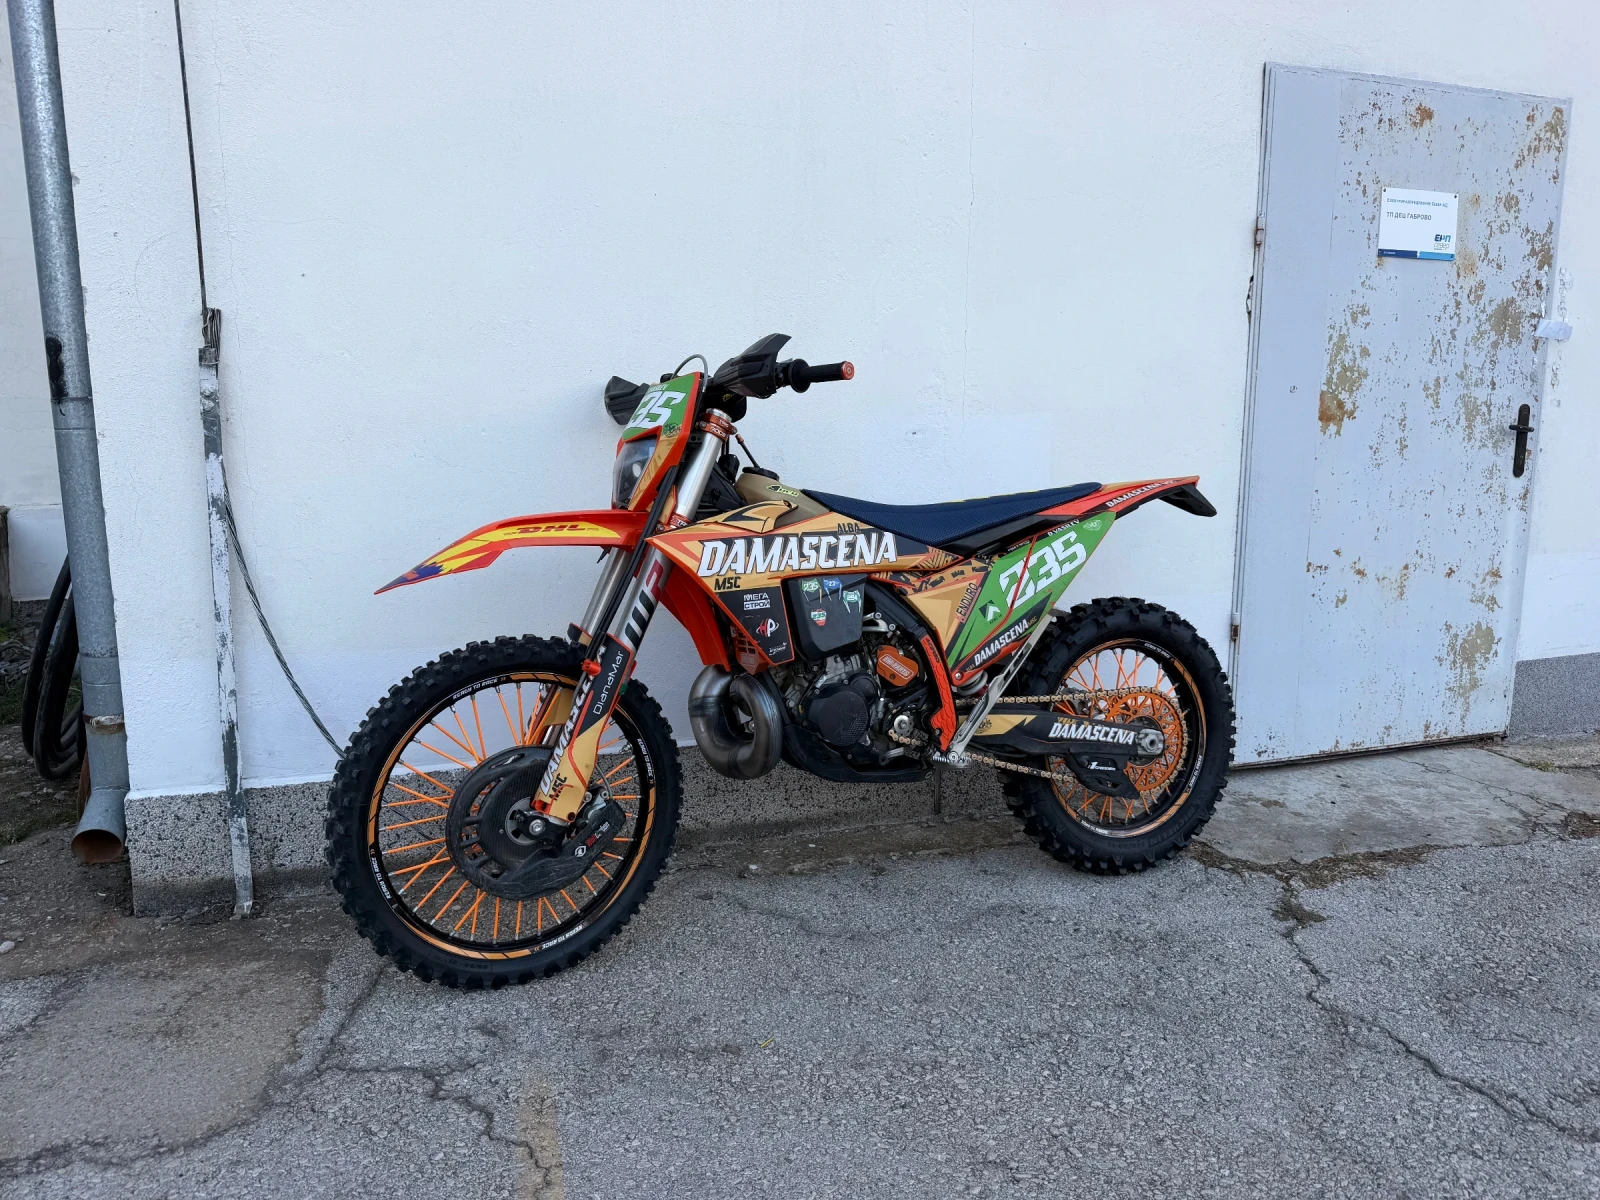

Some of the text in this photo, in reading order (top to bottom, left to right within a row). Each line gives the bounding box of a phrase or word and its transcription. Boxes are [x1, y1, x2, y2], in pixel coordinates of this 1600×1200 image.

[1406, 213, 1432, 221] ГАБРОВО
[1105, 482, 1161, 508] DAMASCENA
[516, 524, 586, 534] DHL
[837, 523, 861, 534] ALBA
[697, 531, 898, 578] DAMASCENA
[999, 530, 1087, 610] 235
[714, 576, 742, 591] MSC
[956, 582, 978, 617] ENDURO
[974, 618, 1030, 667] DAMASCENA
[452, 678, 498, 700] READY TO RACE
[593, 650, 624, 716] DianaMar
[637, 738, 648, 755] READY
[1048, 722, 1136, 745] DAMASCENA
[548, 772, 568, 802] MSC
[371, 857, 392, 900] READY TO RACE
[541, 924, 583, 950] READY TO RACE
